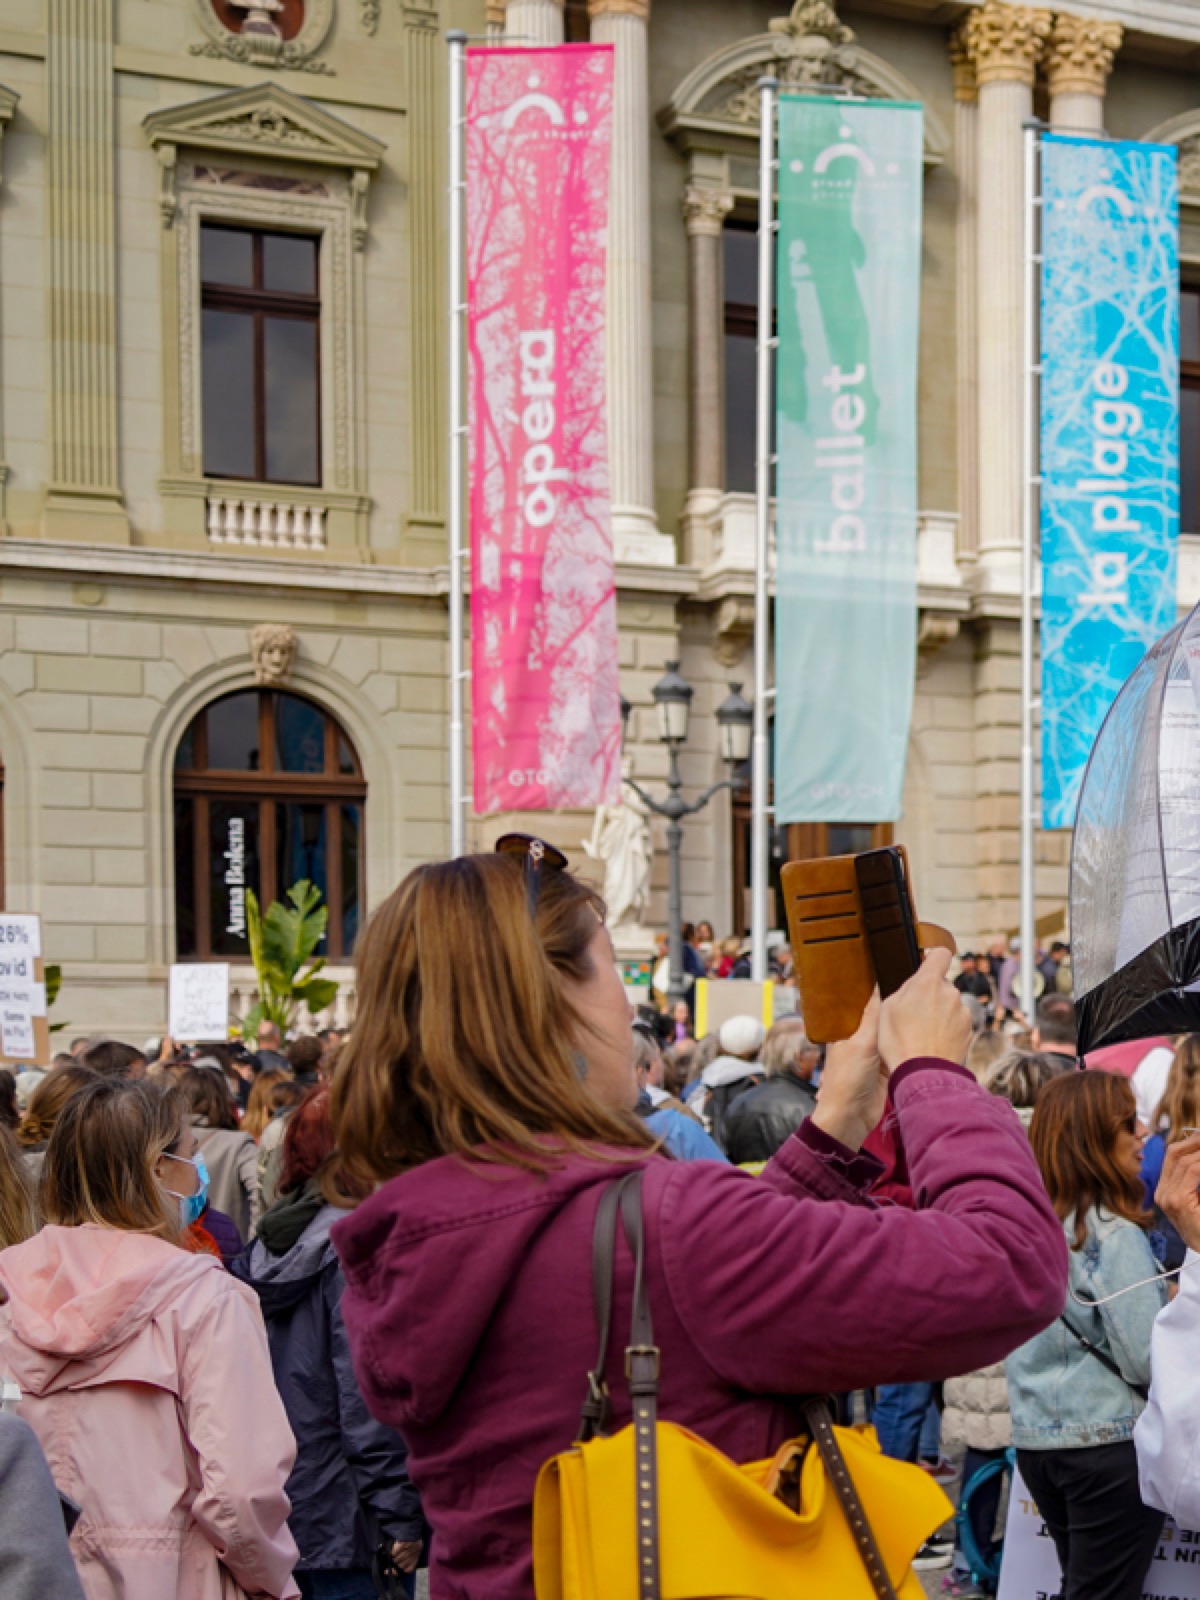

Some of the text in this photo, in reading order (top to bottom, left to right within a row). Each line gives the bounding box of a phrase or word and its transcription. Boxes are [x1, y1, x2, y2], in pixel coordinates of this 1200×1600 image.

[504, 329, 571, 528] opéra
[814, 363, 867, 551] ballet
[1077, 362, 1142, 605] la plage
[223, 817, 246, 939] Anna Bolena
